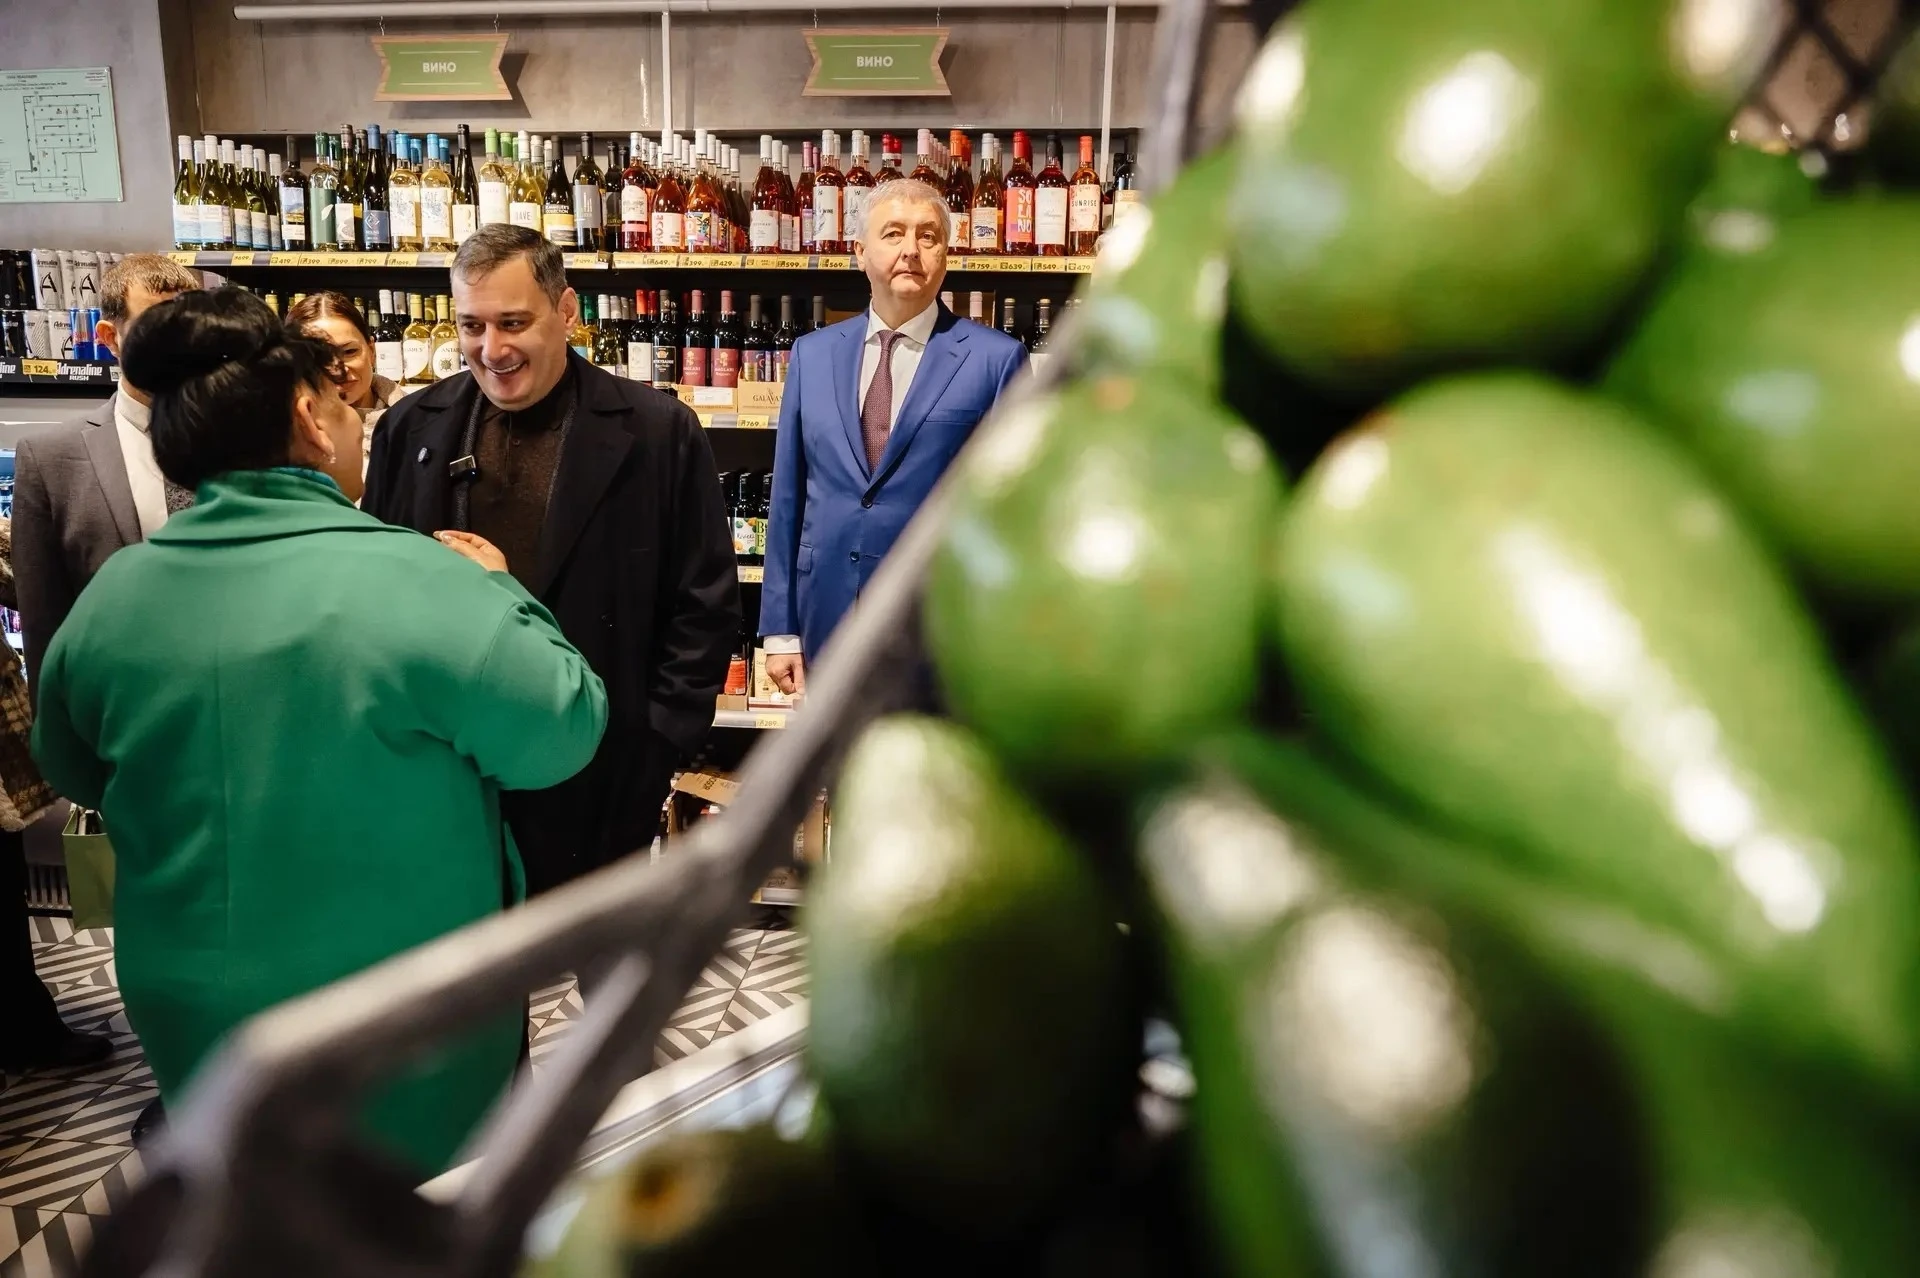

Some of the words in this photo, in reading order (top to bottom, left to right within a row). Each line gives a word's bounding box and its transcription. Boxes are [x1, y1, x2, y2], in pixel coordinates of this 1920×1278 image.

[856, 56, 893, 67] ВИНО
[423, 62, 456, 73] ВИНО
[1018, 189, 1032, 204] SO
[1071, 199, 1097, 207] SUNRISE
[33, 364, 49, 374] 124
